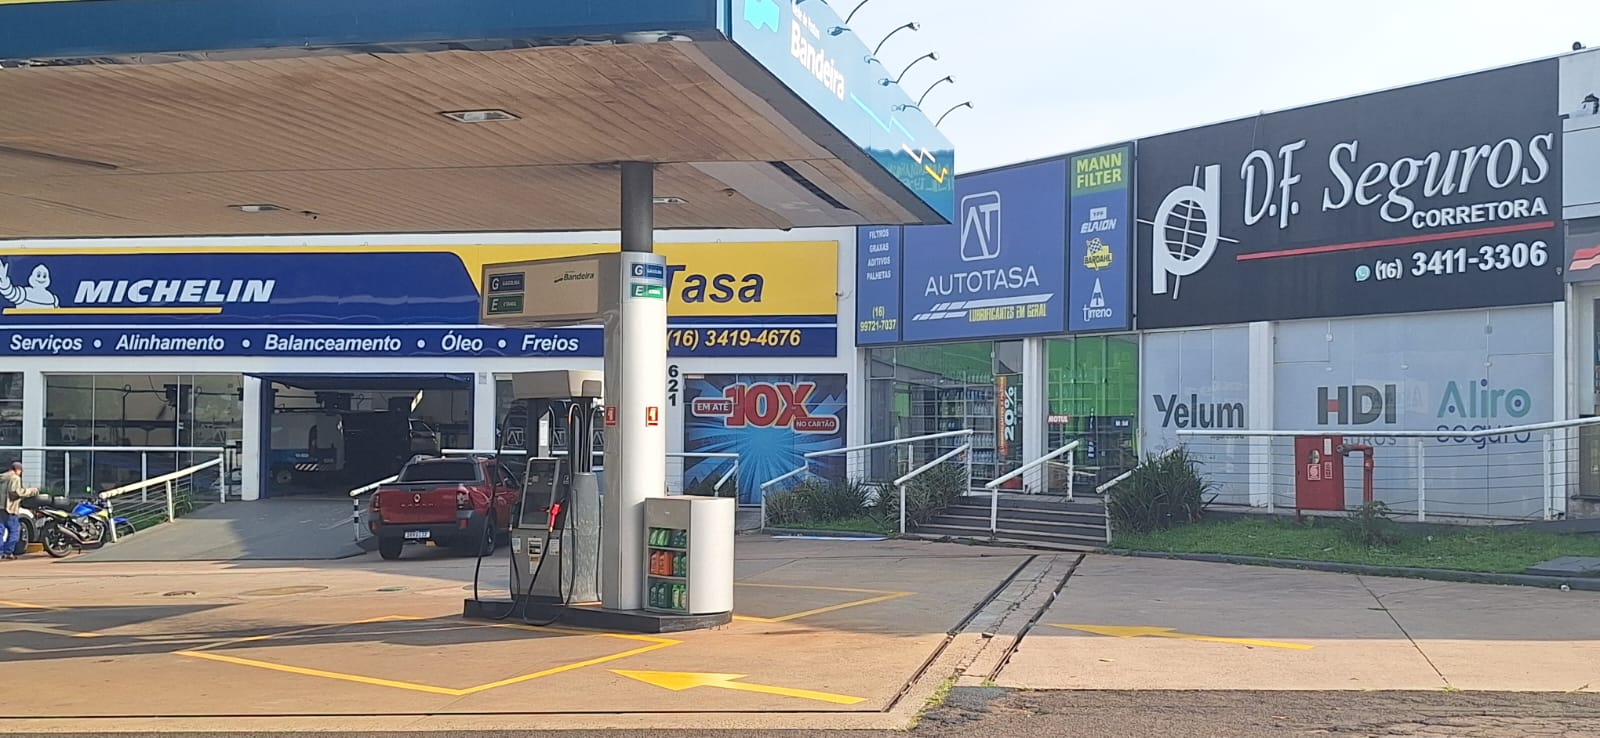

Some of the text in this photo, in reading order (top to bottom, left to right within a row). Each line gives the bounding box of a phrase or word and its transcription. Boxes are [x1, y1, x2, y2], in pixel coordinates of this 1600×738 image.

[791, 18, 845, 101] Bandeira
[1076, 152, 1122, 174] MANN
[1076, 168, 1122, 189] FILTER
[1322, 132, 1554, 223] Seguros
[1412, 197, 1549, 229] CORRETORA
[869, 229, 889, 239] FILTROS
[1080, 218, 1117, 234] ELAION
[869, 243, 889, 253] GRAXAS
[868, 256, 891, 267] ADITIVOS
[1375, 241, 1548, 281] (16) 3411-3306
[492, 278, 499, 290] G
[563, 271, 594, 281] Bandeira
[866, 270, 891, 280] PALHETAS
[924, 265, 1040, 297] AUTOTASA
[74, 280, 275, 304] MICHELIN
[491, 299, 499, 311] E
[968, 306, 1014, 323] LUBRIFICANTES
[1027, 303, 1047, 317] GERAL
[10, 330, 579, 354] Serviços Alinhamento Balanceamento Óleo Freios
[667, 329, 802, 351] (16) 3419-4676
[697, 401, 729, 411] EM ATÉ
[725, 384, 814, 427] 10X
[1317, 383, 1397, 425] HDI
[1436, 378, 1532, 418] Aliro
[1004, 386, 1015, 441] 20%
[1152, 393, 1244, 428] Yelum
[807, 419, 835, 428] CARTÃO
